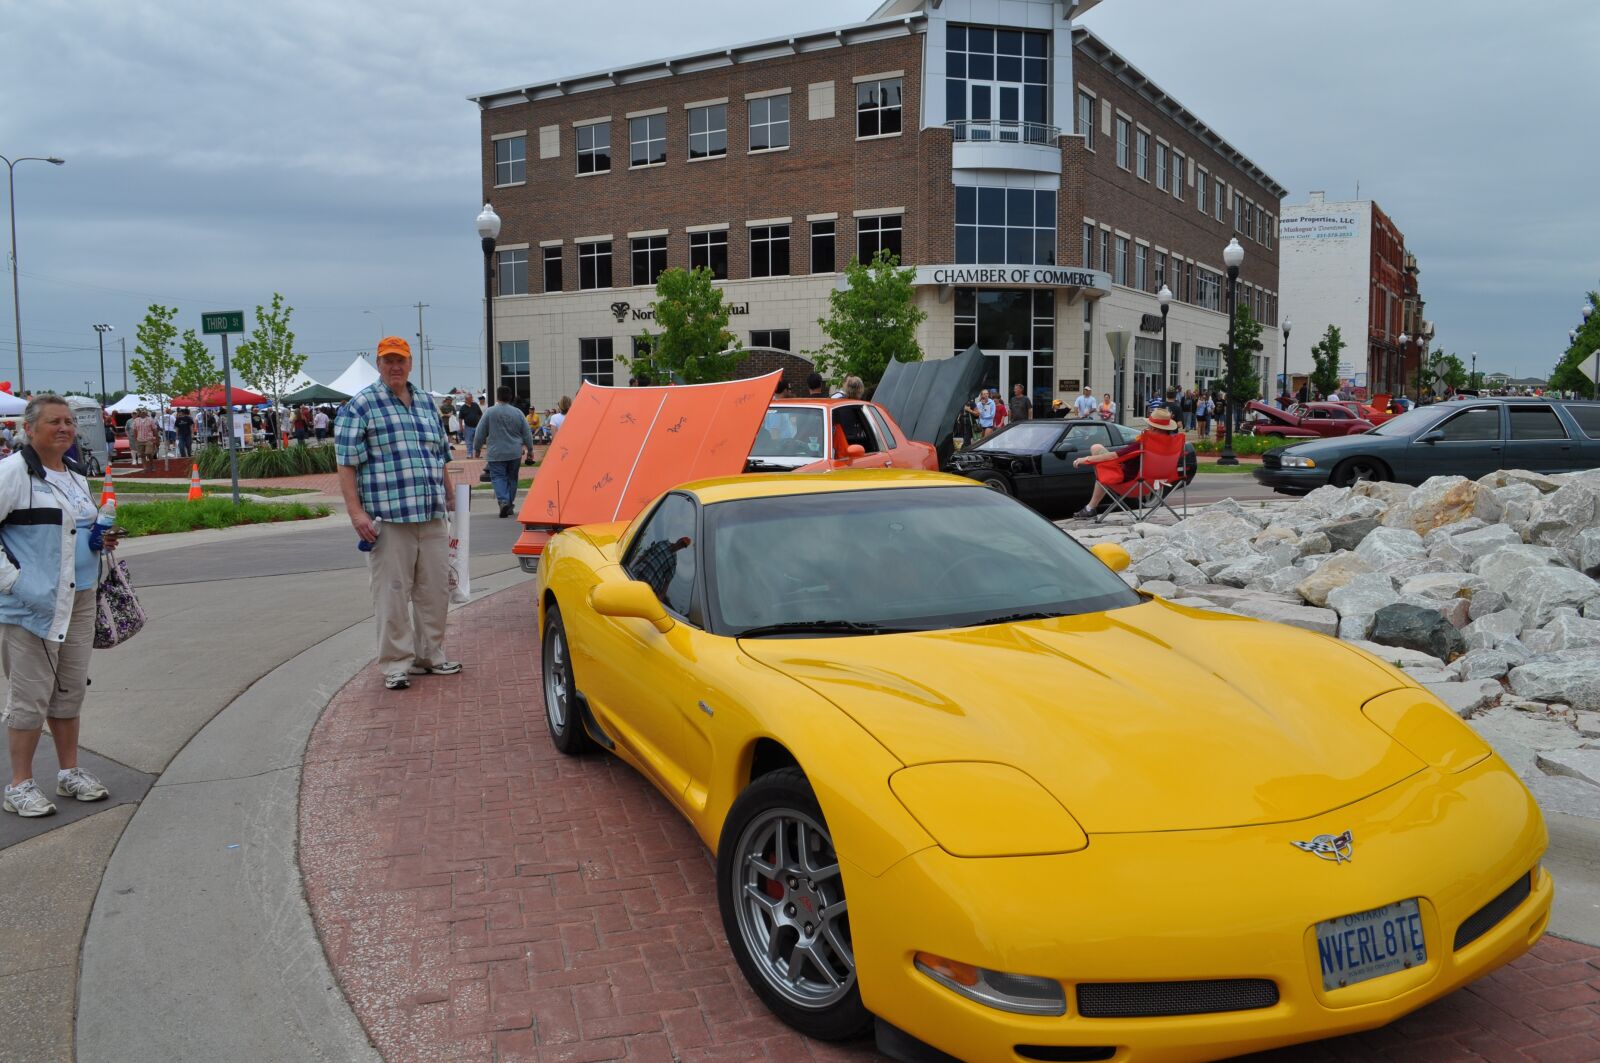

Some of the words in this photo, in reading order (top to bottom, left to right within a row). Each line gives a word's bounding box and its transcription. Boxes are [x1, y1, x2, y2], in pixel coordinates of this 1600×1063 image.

[1300, 216, 1338, 224] Properties,
[934, 269, 1007, 283] CHAMBER
[1011, 269, 1031, 283] OF
[1034, 270, 1095, 287] COMMERCE
[206, 316, 228, 331] THIRD
[1344, 907, 1389, 927] ONTARIO
[1317, 912, 1425, 977] NVERL8TE
